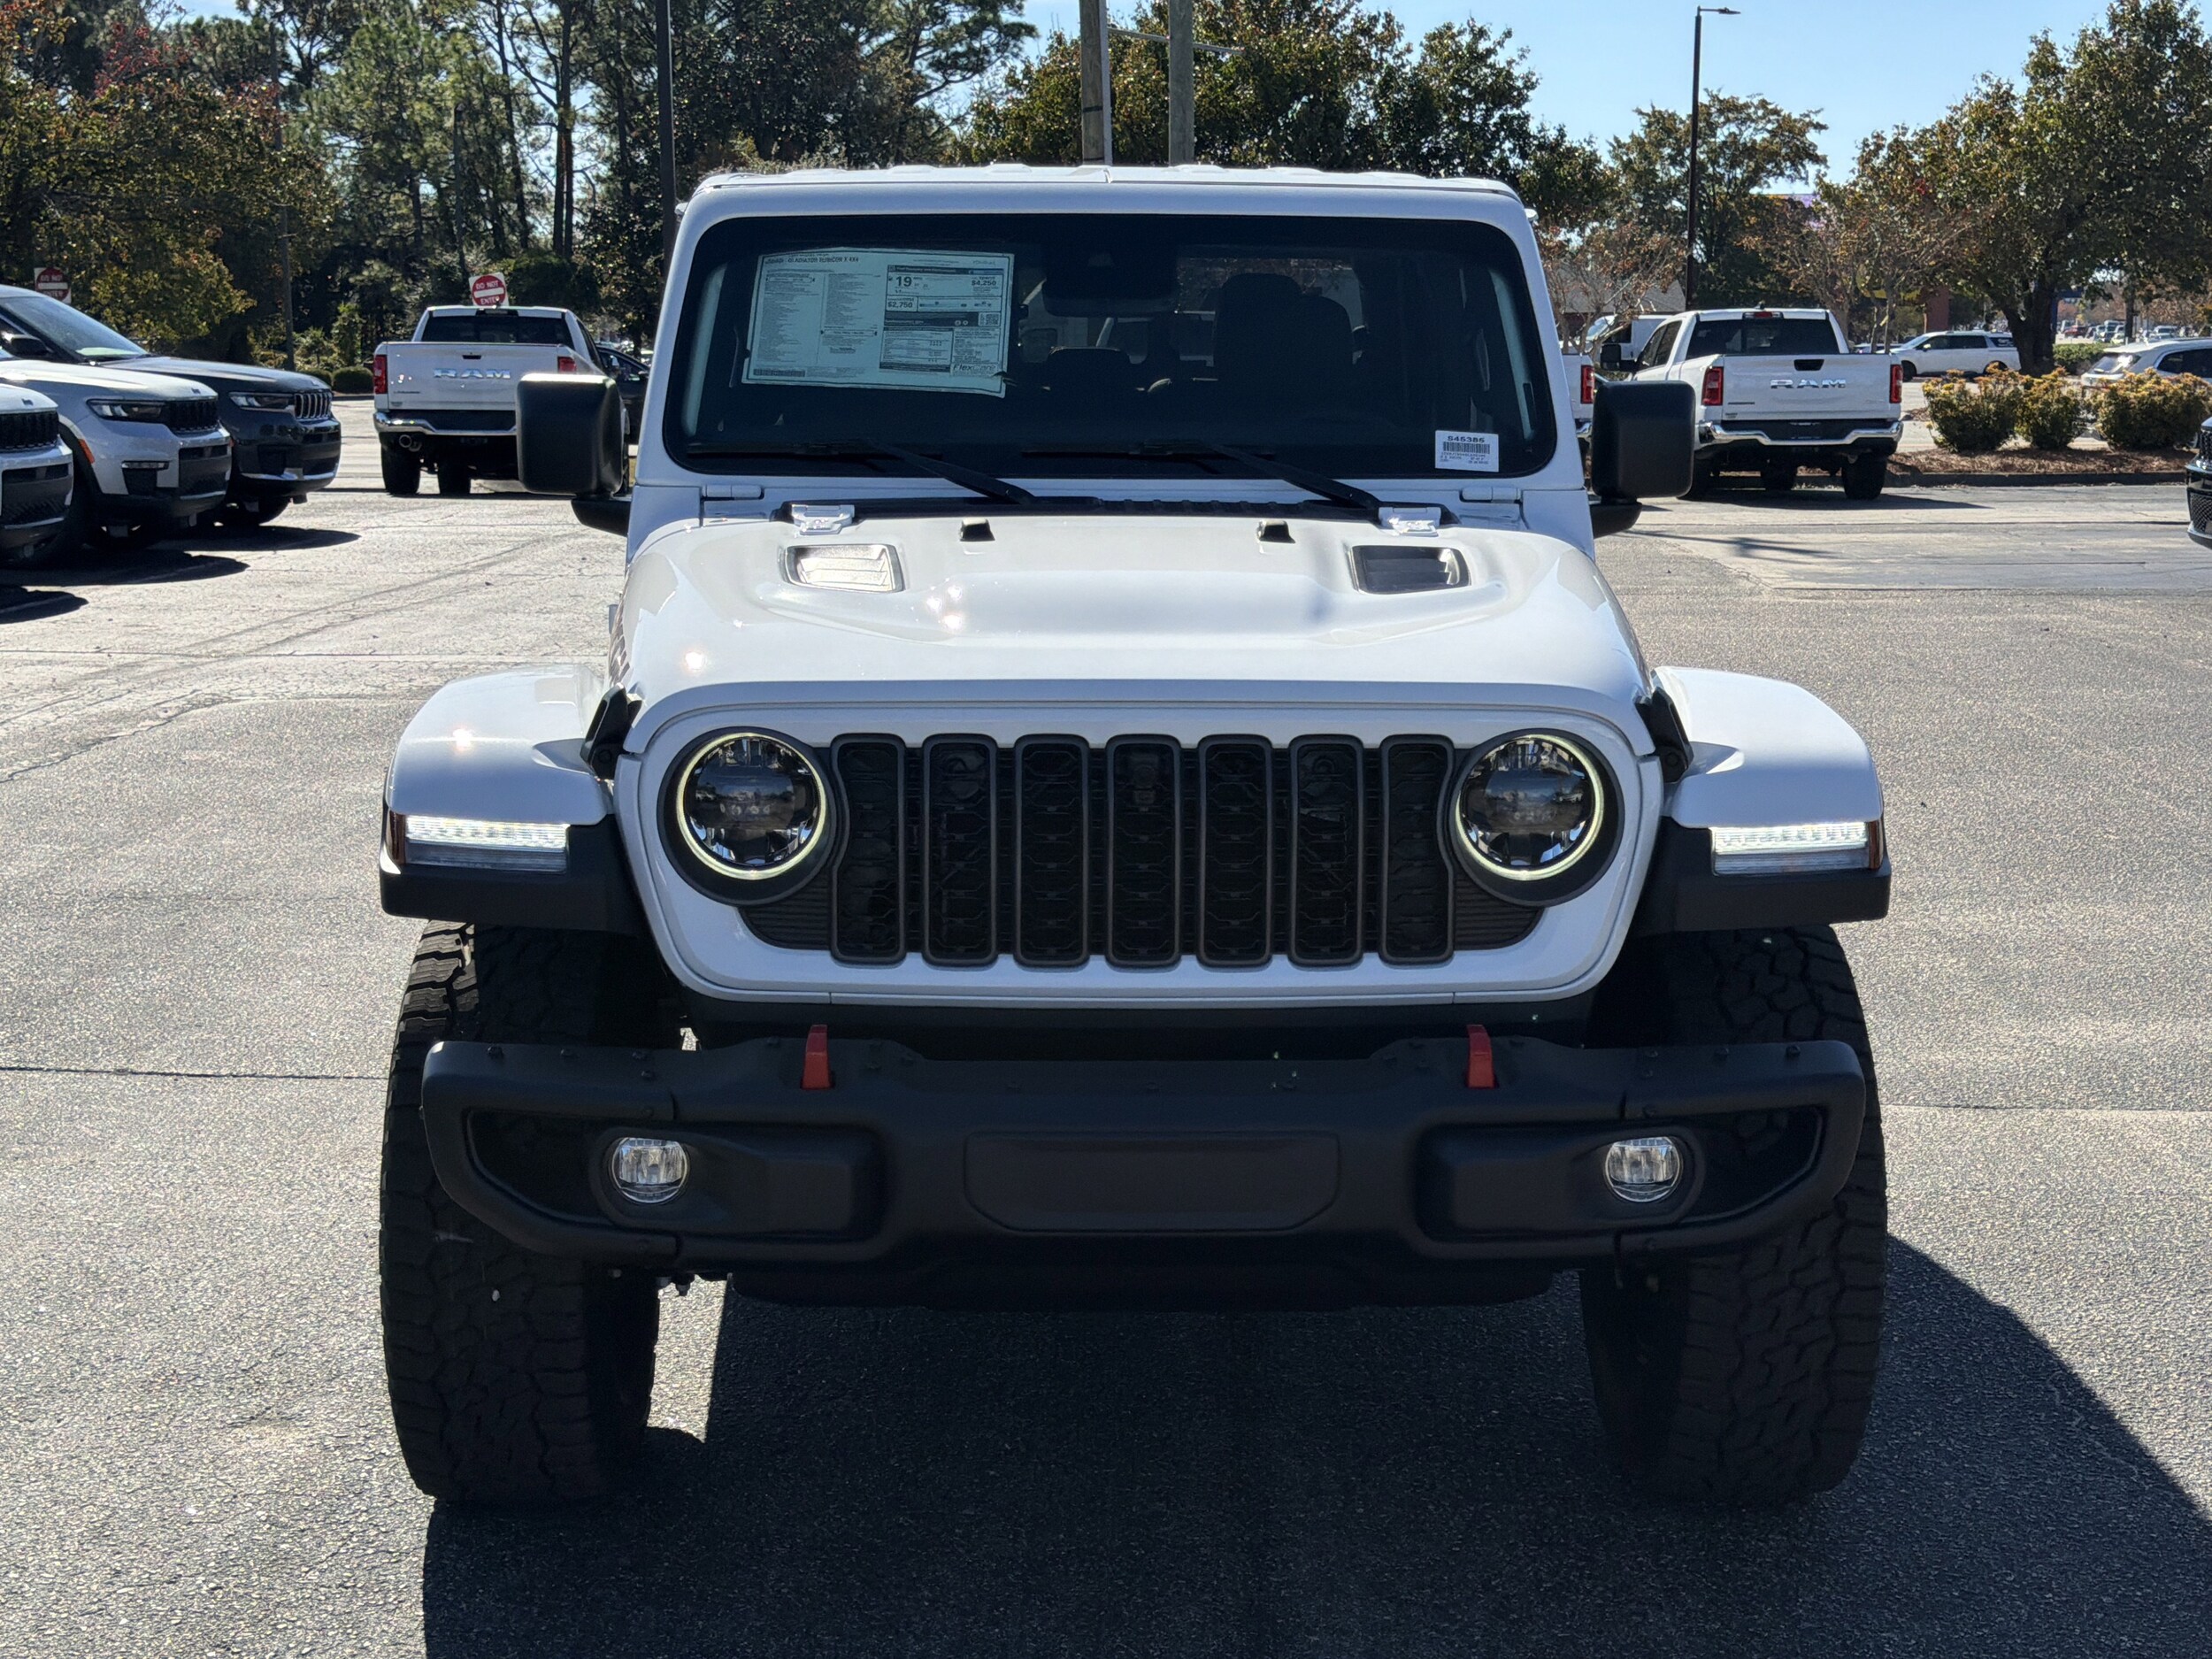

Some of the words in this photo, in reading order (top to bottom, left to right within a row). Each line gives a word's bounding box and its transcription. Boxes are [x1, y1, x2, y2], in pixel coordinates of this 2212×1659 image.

[895, 276, 912, 287] 19
[433, 368, 511, 379] RAM
[1770, 380, 1847, 388] RAM
